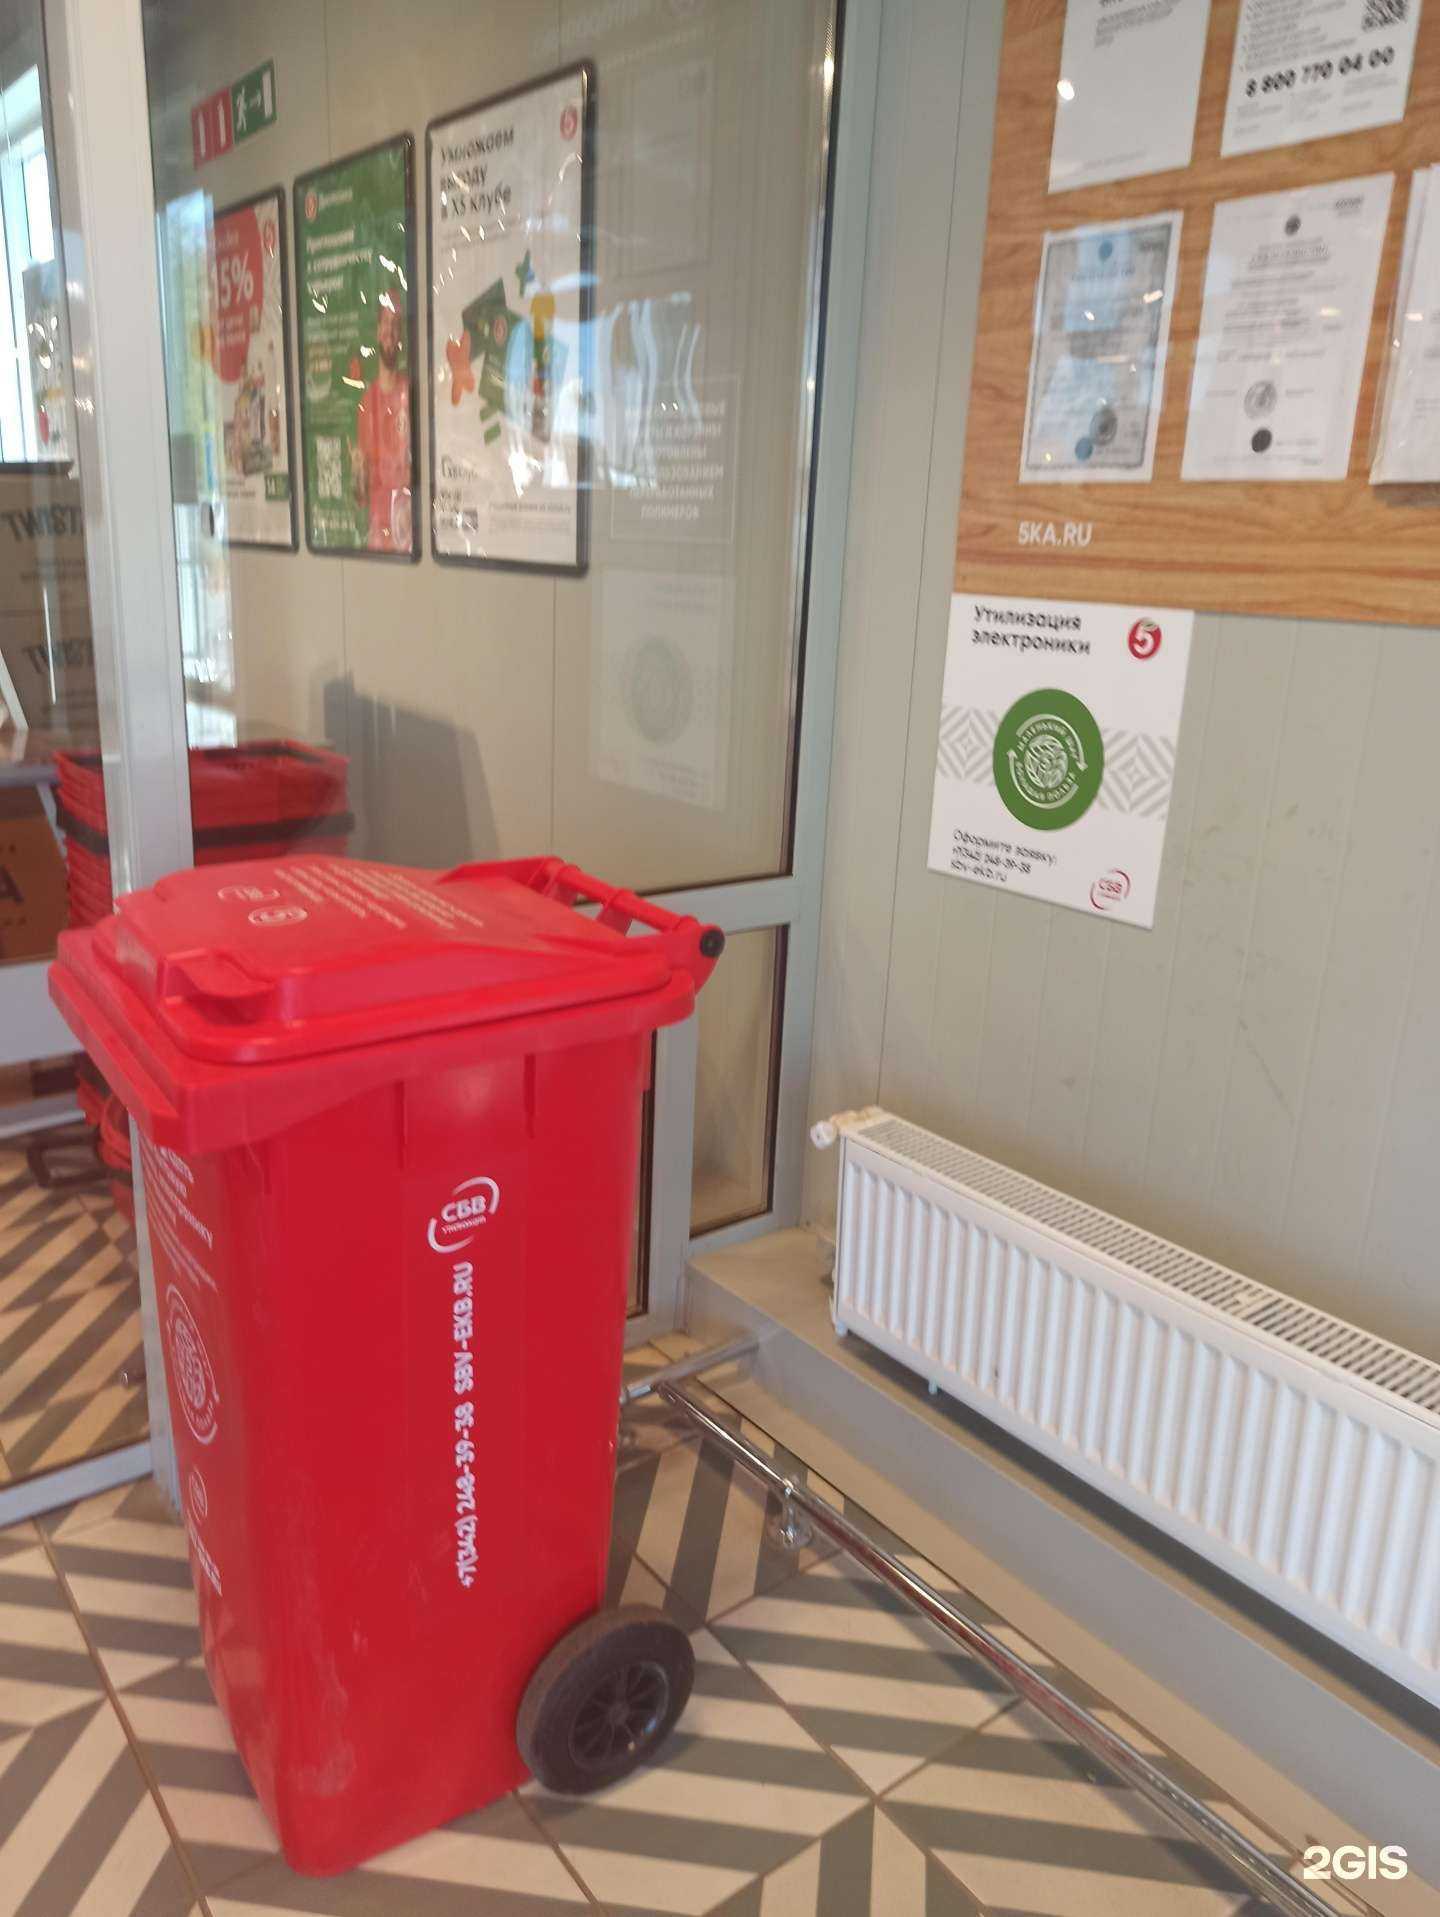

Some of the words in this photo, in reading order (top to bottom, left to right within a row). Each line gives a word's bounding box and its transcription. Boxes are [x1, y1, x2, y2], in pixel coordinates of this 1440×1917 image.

[1246, 78, 1258, 98] 8
[1262, 69, 1296, 93] 800
[1302, 60, 1334, 84] 770
[1368, 46, 1395, 69] 00
[1, 504, 83, 541] TWIST
[1018, 520, 1094, 548] 5KA.RU
[974, 605, 1082, 633] Утилизация
[972, 629, 1091, 656] электроники
[441, 1195, 487, 1223] СБВ
[453, 1261, 474, 1395] SBV-EKB.RU
[454, 1402, 477, 1513] 248-39-38
